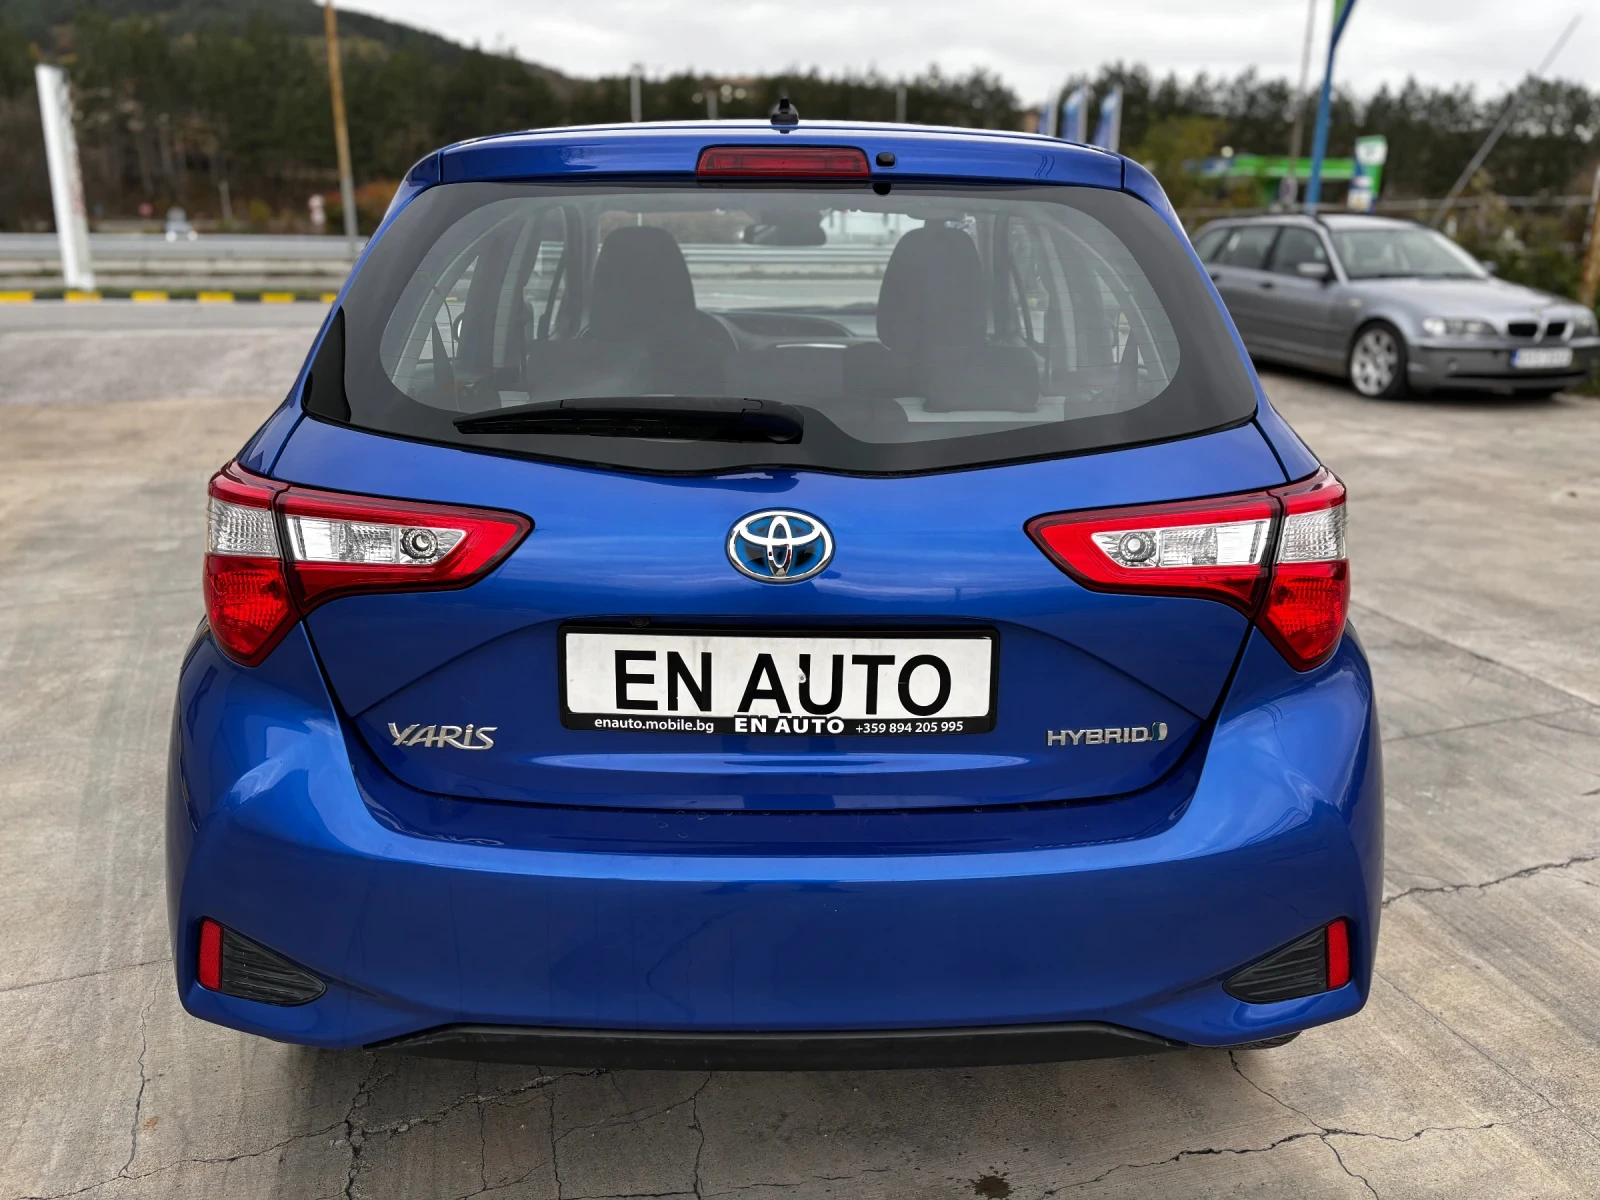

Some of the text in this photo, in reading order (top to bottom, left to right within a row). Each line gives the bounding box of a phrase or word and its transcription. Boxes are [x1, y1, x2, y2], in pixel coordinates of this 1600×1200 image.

[614, 649, 952, 716] EN AUTO
[594, 718, 714, 733] enauto.mobile.bg
[734, 717, 845, 734] EN AUTO
[855, 721, 964, 734] +359 894 205 995
[1047, 726, 1149, 746] HYBRID
